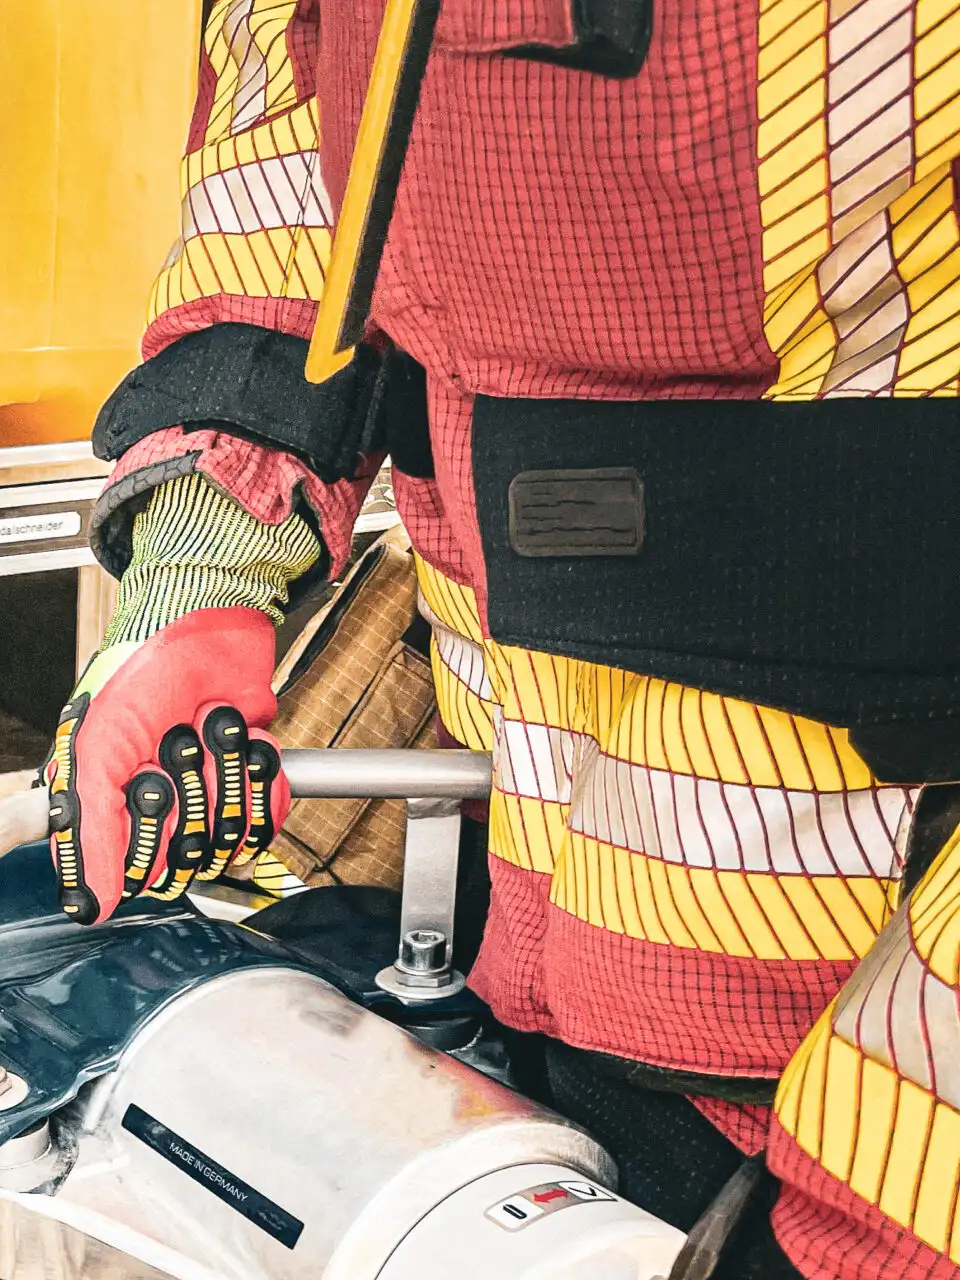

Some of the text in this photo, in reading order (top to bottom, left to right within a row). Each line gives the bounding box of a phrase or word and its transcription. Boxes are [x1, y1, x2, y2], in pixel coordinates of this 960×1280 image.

[169, 1142, 249, 1202] MADE IN GERMANY
